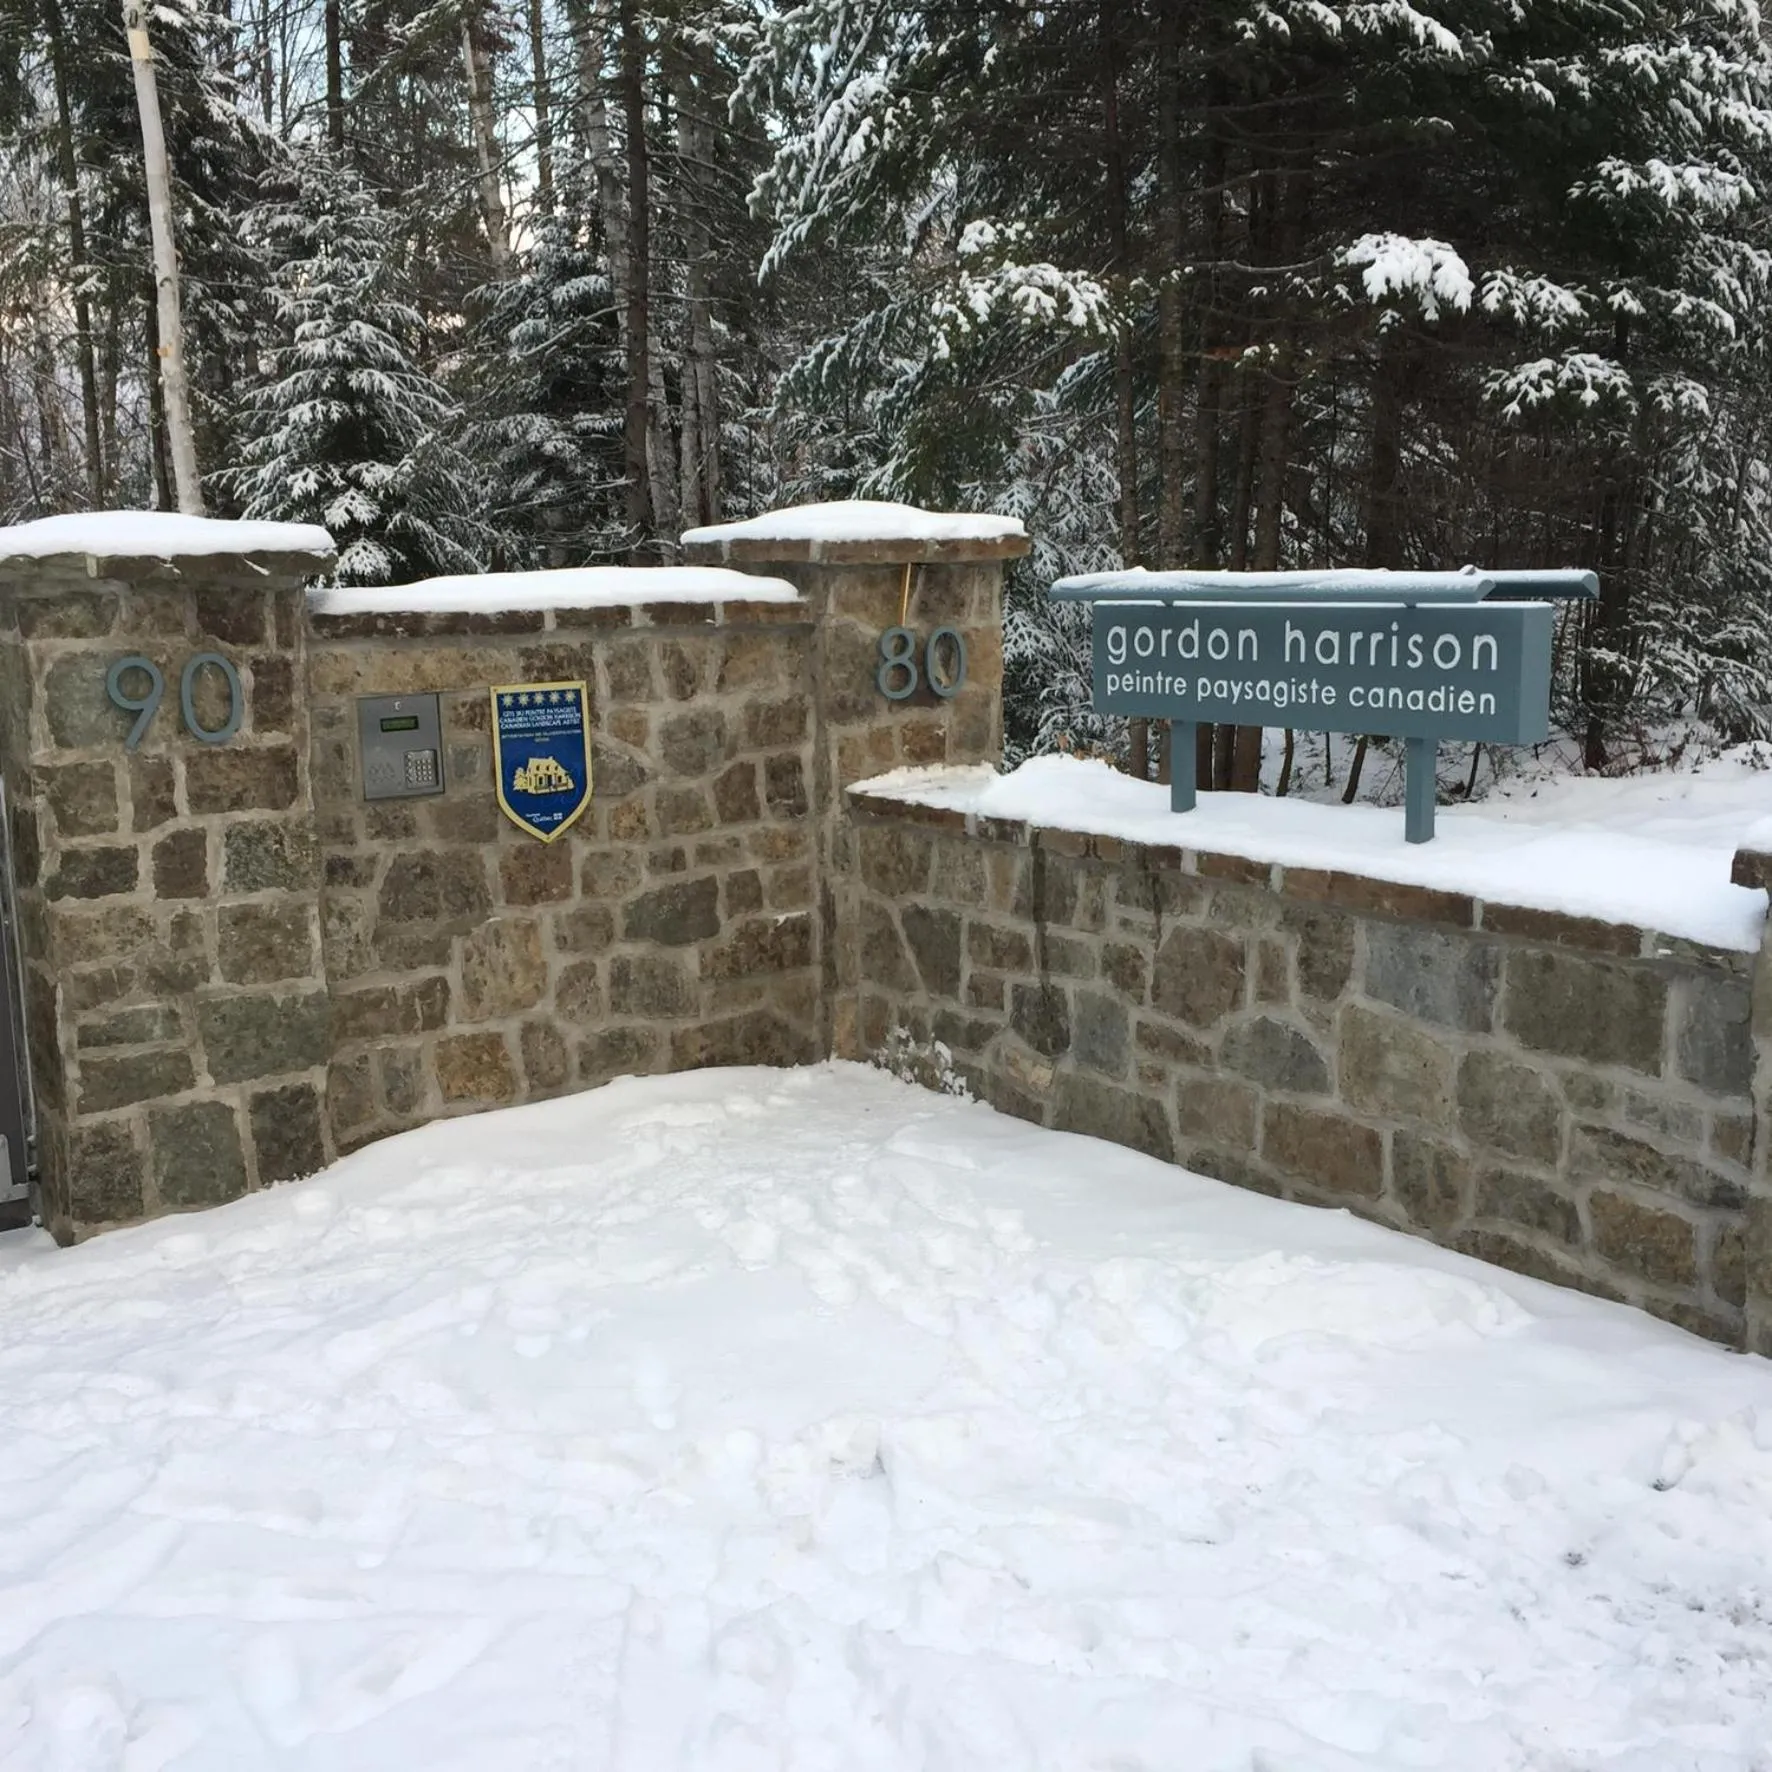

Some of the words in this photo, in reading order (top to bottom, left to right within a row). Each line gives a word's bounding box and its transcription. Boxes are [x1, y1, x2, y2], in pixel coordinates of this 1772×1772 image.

[878, 626, 967, 700] 80
[1107, 619, 1258, 665] gordon
[1285, 620, 1498, 671] harrison
[107, 652, 243, 751] 90
[1107, 669, 1187, 696] peintre
[1197, 677, 1337, 708] paysagiste
[1349, 685, 1496, 715] canadien
